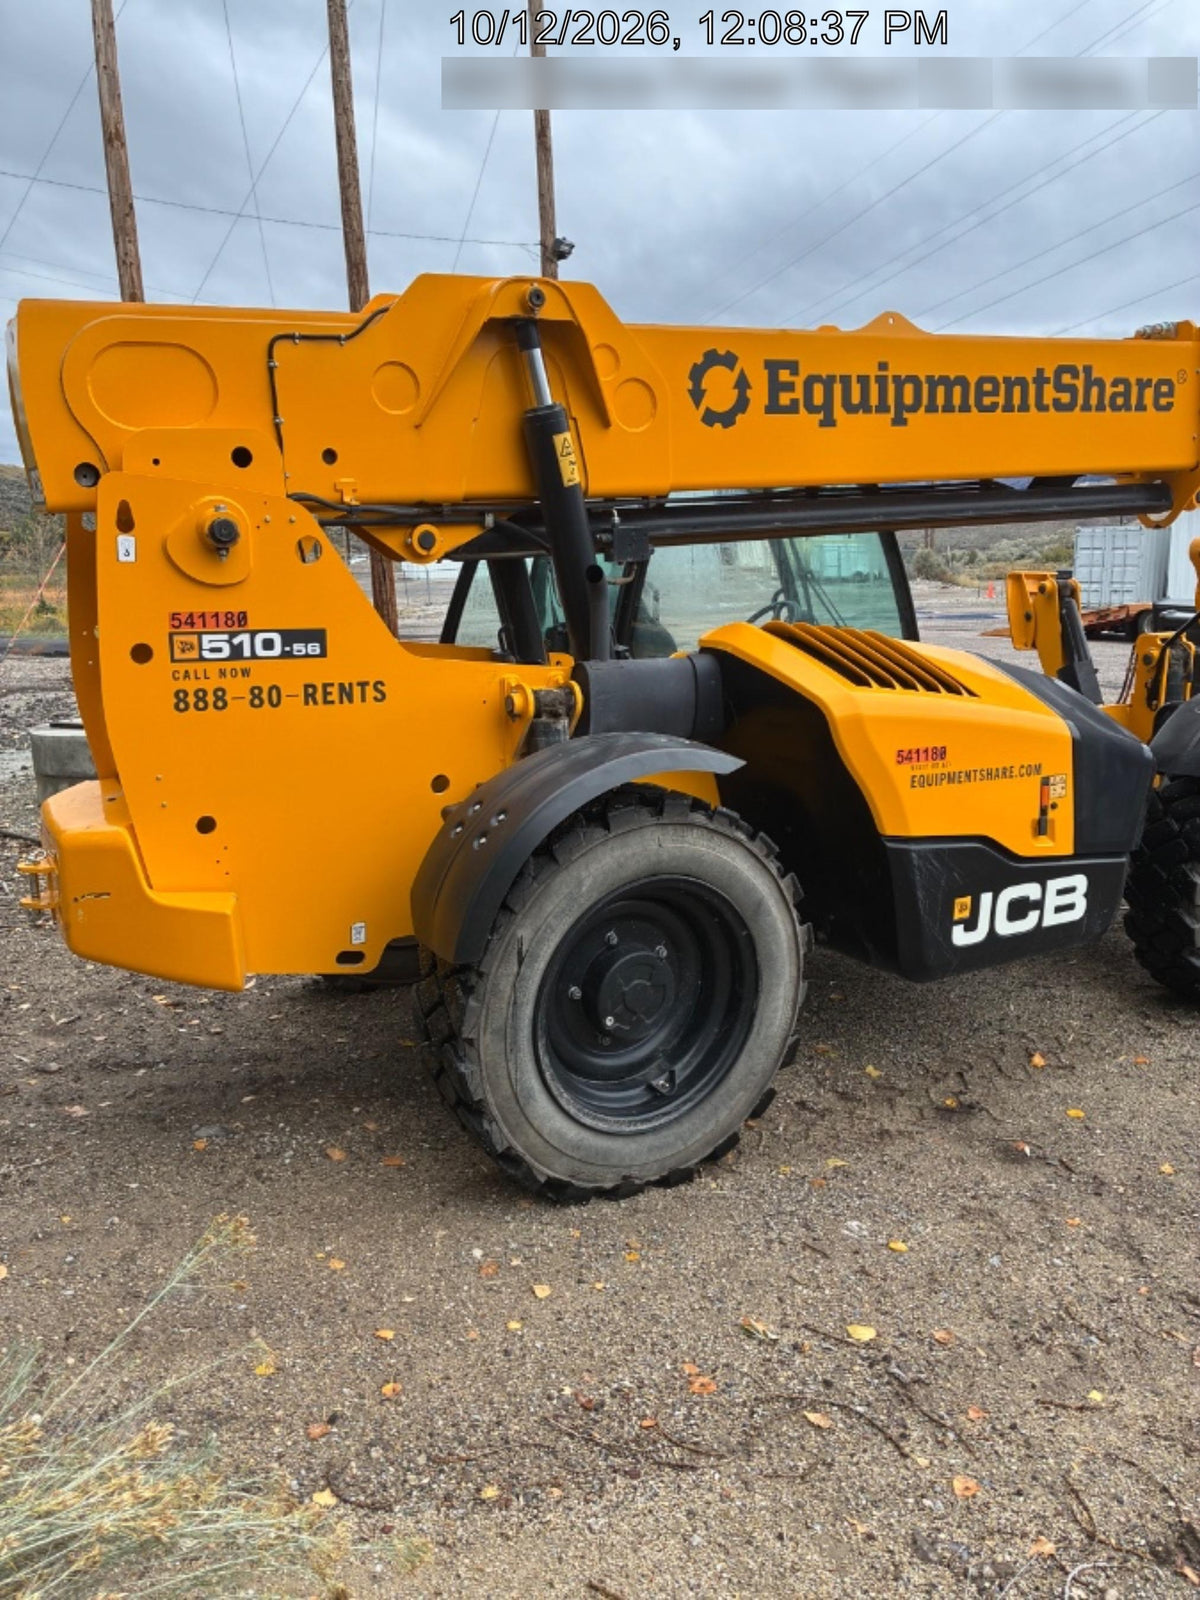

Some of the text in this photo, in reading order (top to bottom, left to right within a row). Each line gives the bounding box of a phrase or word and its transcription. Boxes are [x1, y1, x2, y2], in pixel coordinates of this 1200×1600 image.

[763, 358, 1176, 428] EquipmentShare
[171, 610, 248, 629] 541180
[201, 631, 321, 659] 510-56
[172, 667, 251, 681] CALL NOW
[173, 680, 387, 713] 888-80-RENTS
[896, 746, 947, 765] 541180
[910, 763, 1042, 789] EQUIPMENTSHARE.COM
[952, 874, 1088, 947] JCB
